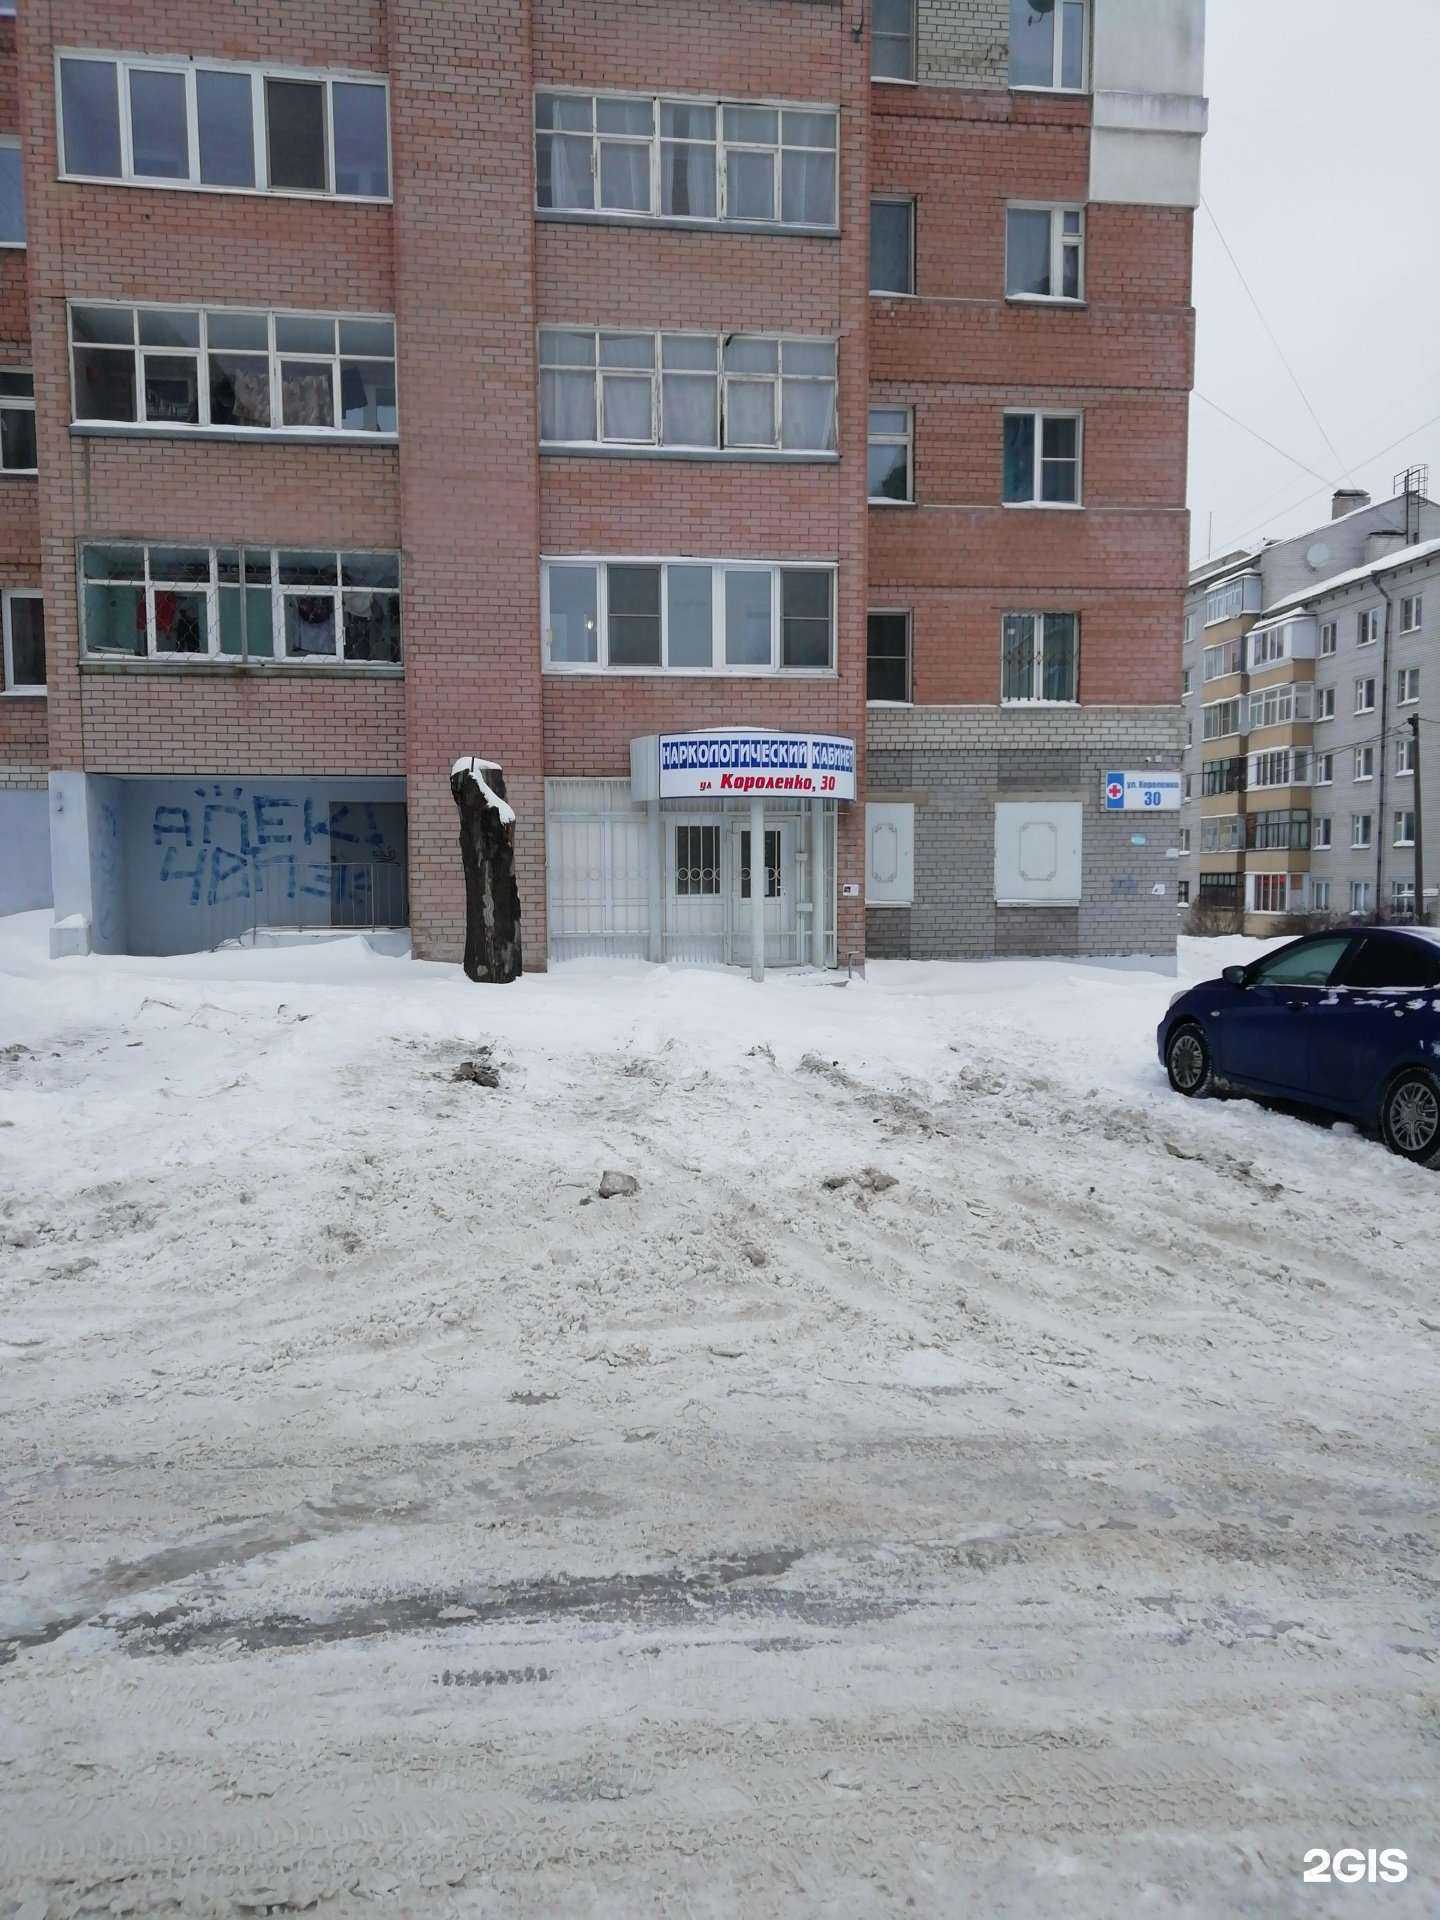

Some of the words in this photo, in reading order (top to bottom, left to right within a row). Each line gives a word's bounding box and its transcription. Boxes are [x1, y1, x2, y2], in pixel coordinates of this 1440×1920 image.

[663, 742, 807, 766] НАРКОЛОГИЧЕСКИЙ
[700, 781, 712, 791] ул
[720, 773, 816, 792] Короленко,
[821, 776, 836, 790] 30
[1144, 791, 1161, 806] 30
